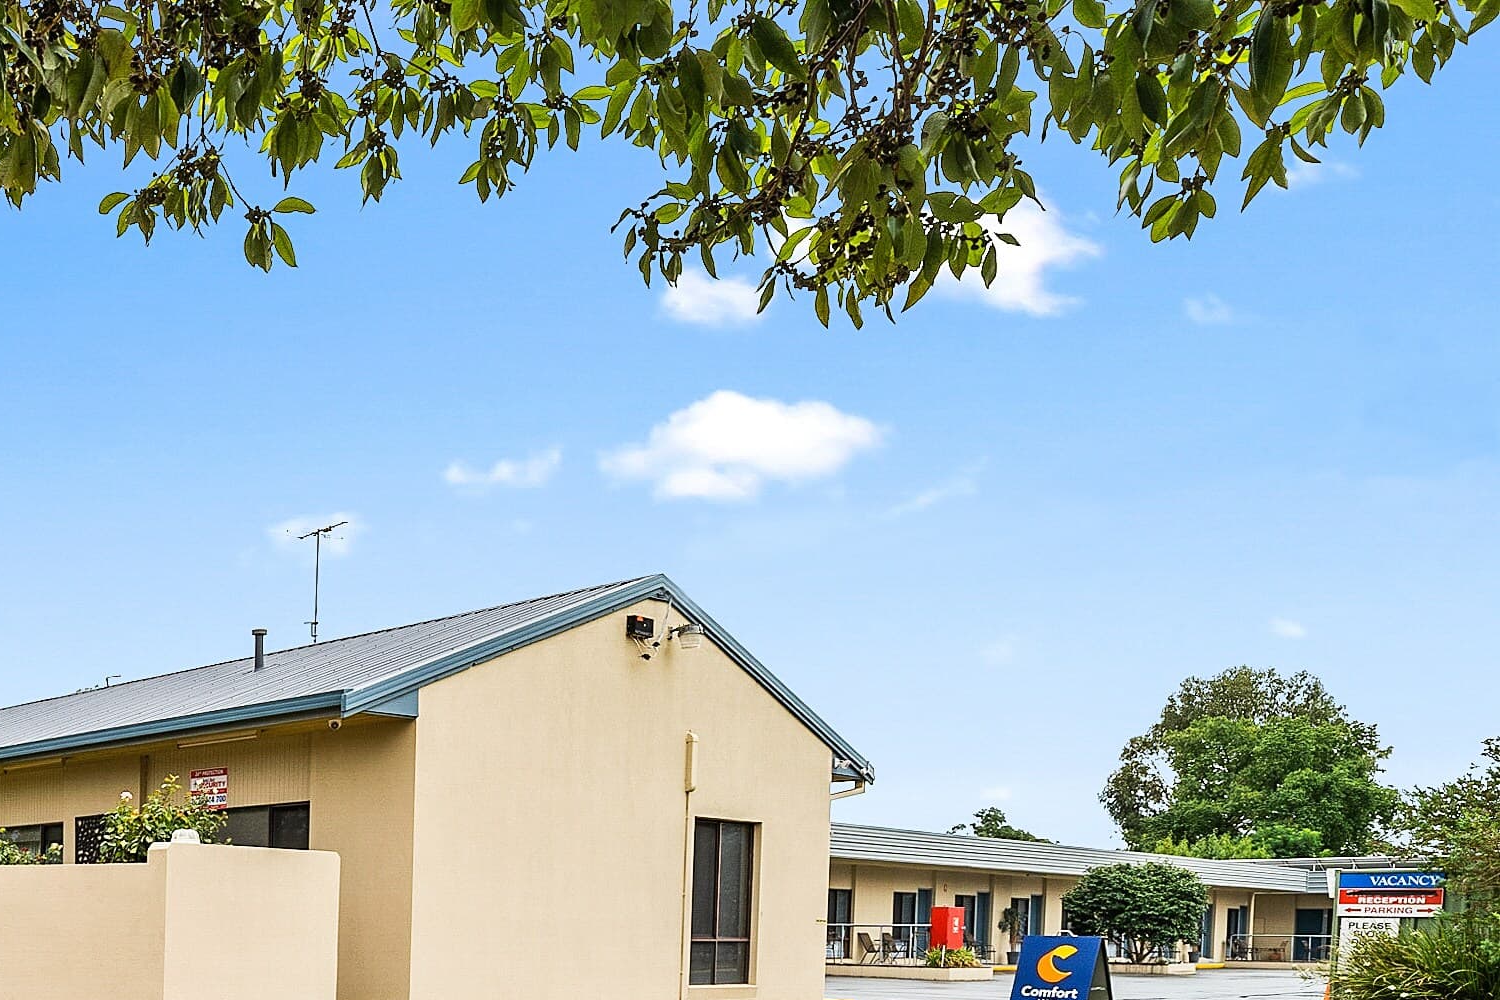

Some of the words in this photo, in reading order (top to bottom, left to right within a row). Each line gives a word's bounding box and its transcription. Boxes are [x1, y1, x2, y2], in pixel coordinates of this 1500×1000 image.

[1370, 875, 1441, 886] VACANCY
[1357, 896, 1426, 904] RECEPTION
[1348, 921, 1392, 930] PLEASE
[1021, 985, 1079, 1000] Comfort
